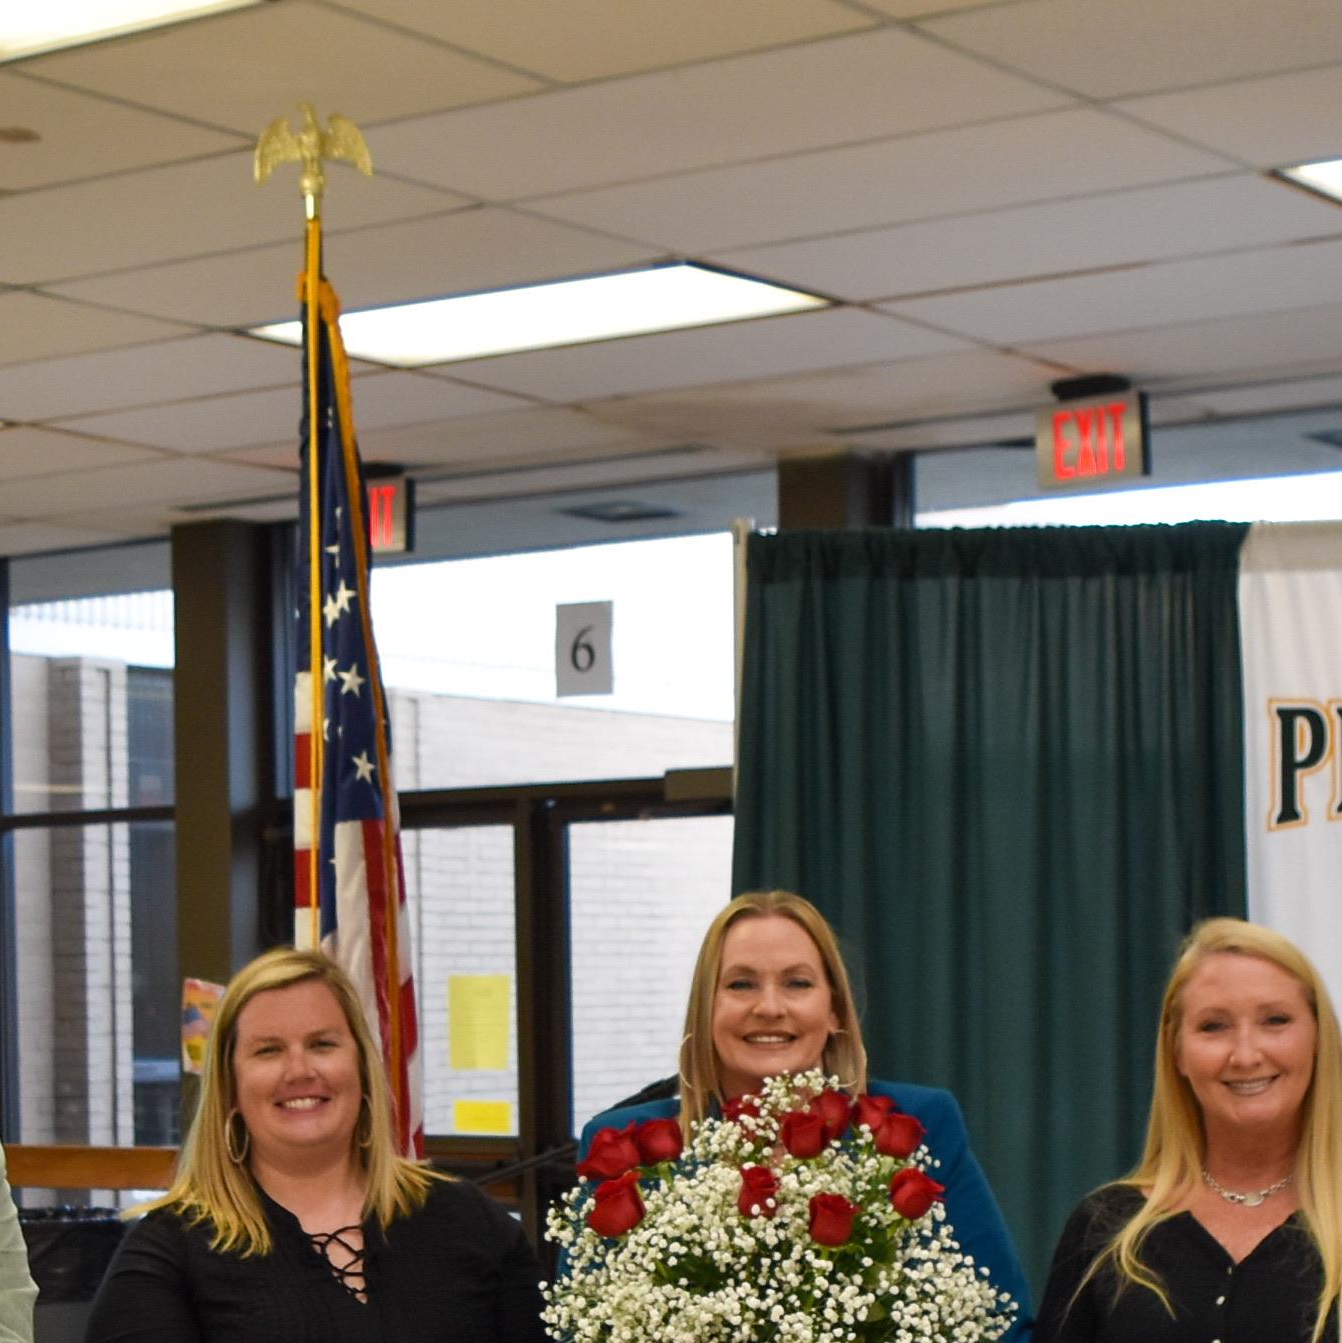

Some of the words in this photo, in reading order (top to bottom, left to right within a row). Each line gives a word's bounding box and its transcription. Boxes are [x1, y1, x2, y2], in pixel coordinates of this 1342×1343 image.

[1052, 403, 1128, 480] EXIT
[370, 484, 397, 547] IT
[571, 624, 596, 673] 6
